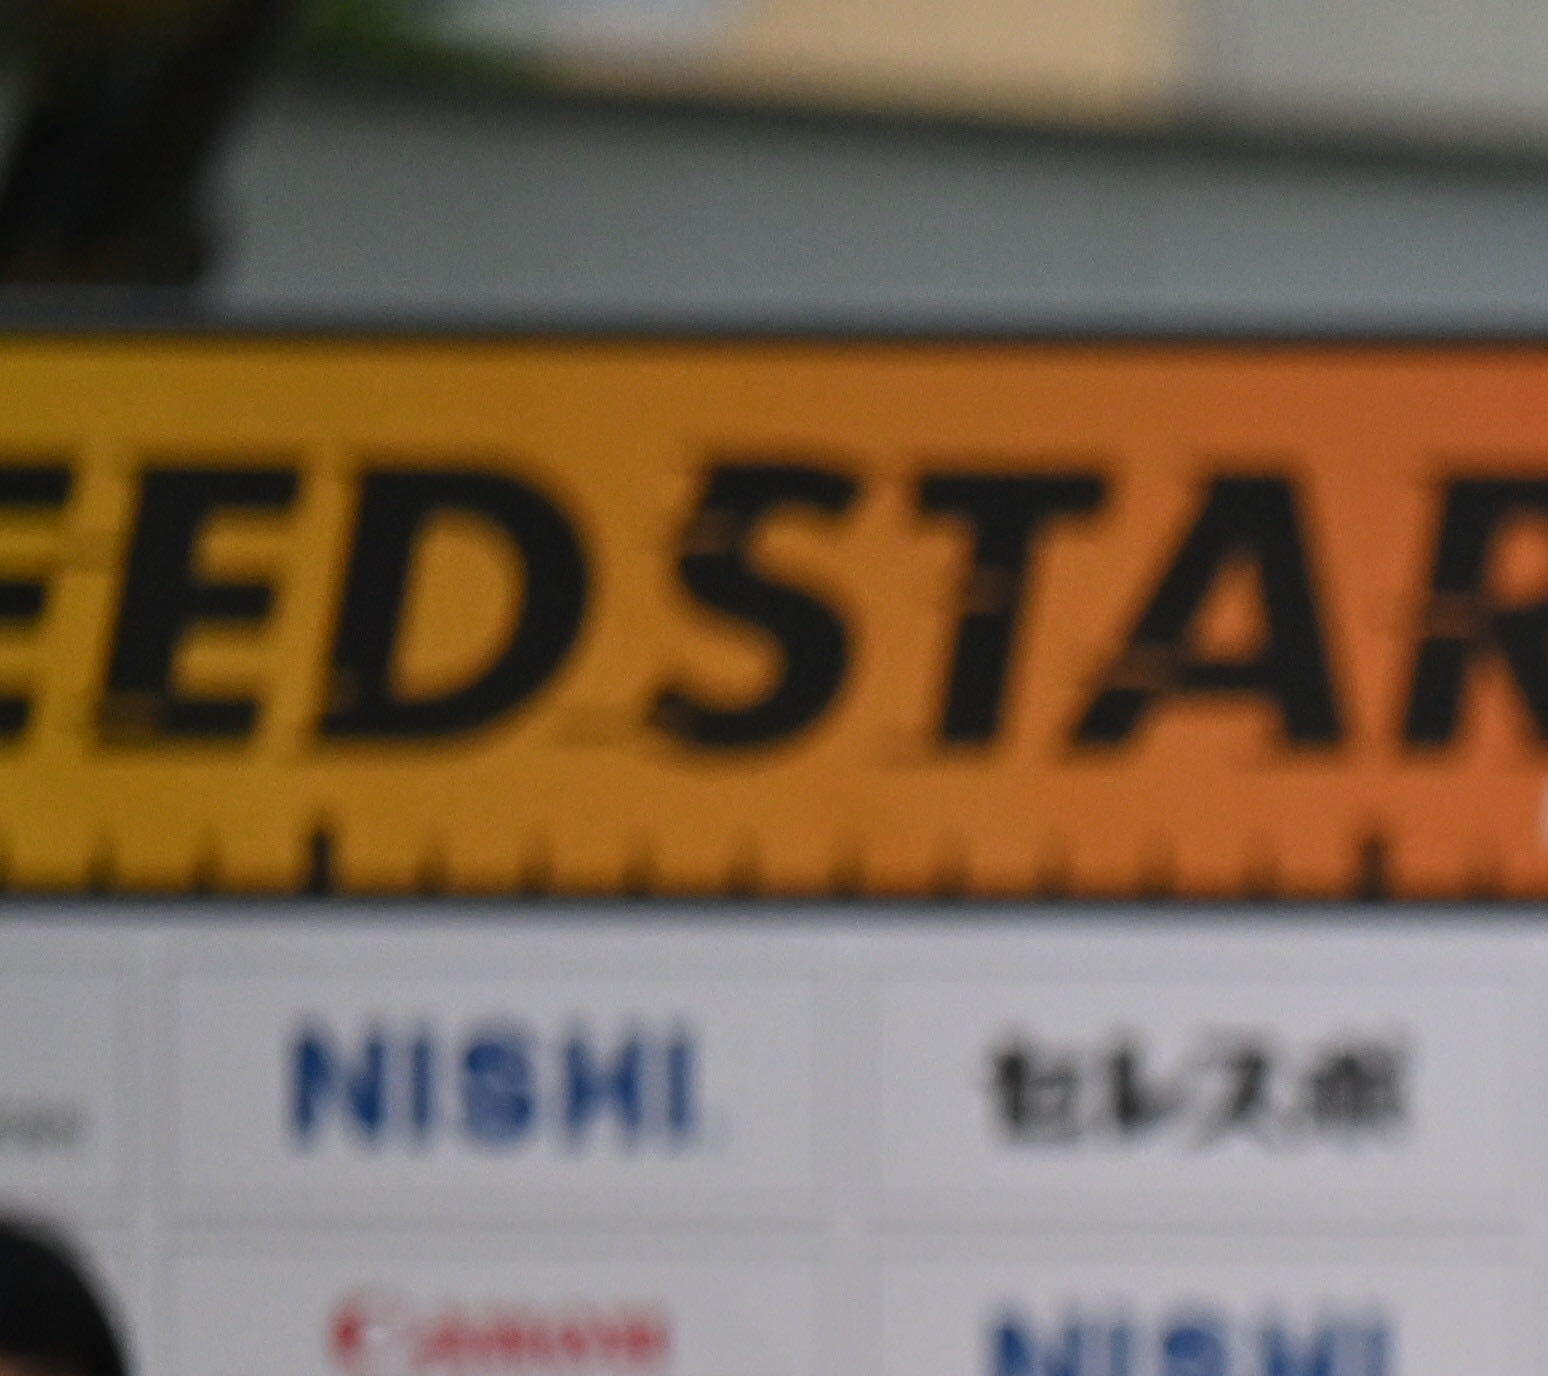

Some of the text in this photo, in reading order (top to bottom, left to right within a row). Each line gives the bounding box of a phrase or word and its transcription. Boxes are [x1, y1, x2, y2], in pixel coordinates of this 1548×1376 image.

[285, 1024, 696, 1146] NISHI
[988, 1032, 1410, 1145] セレスポ
